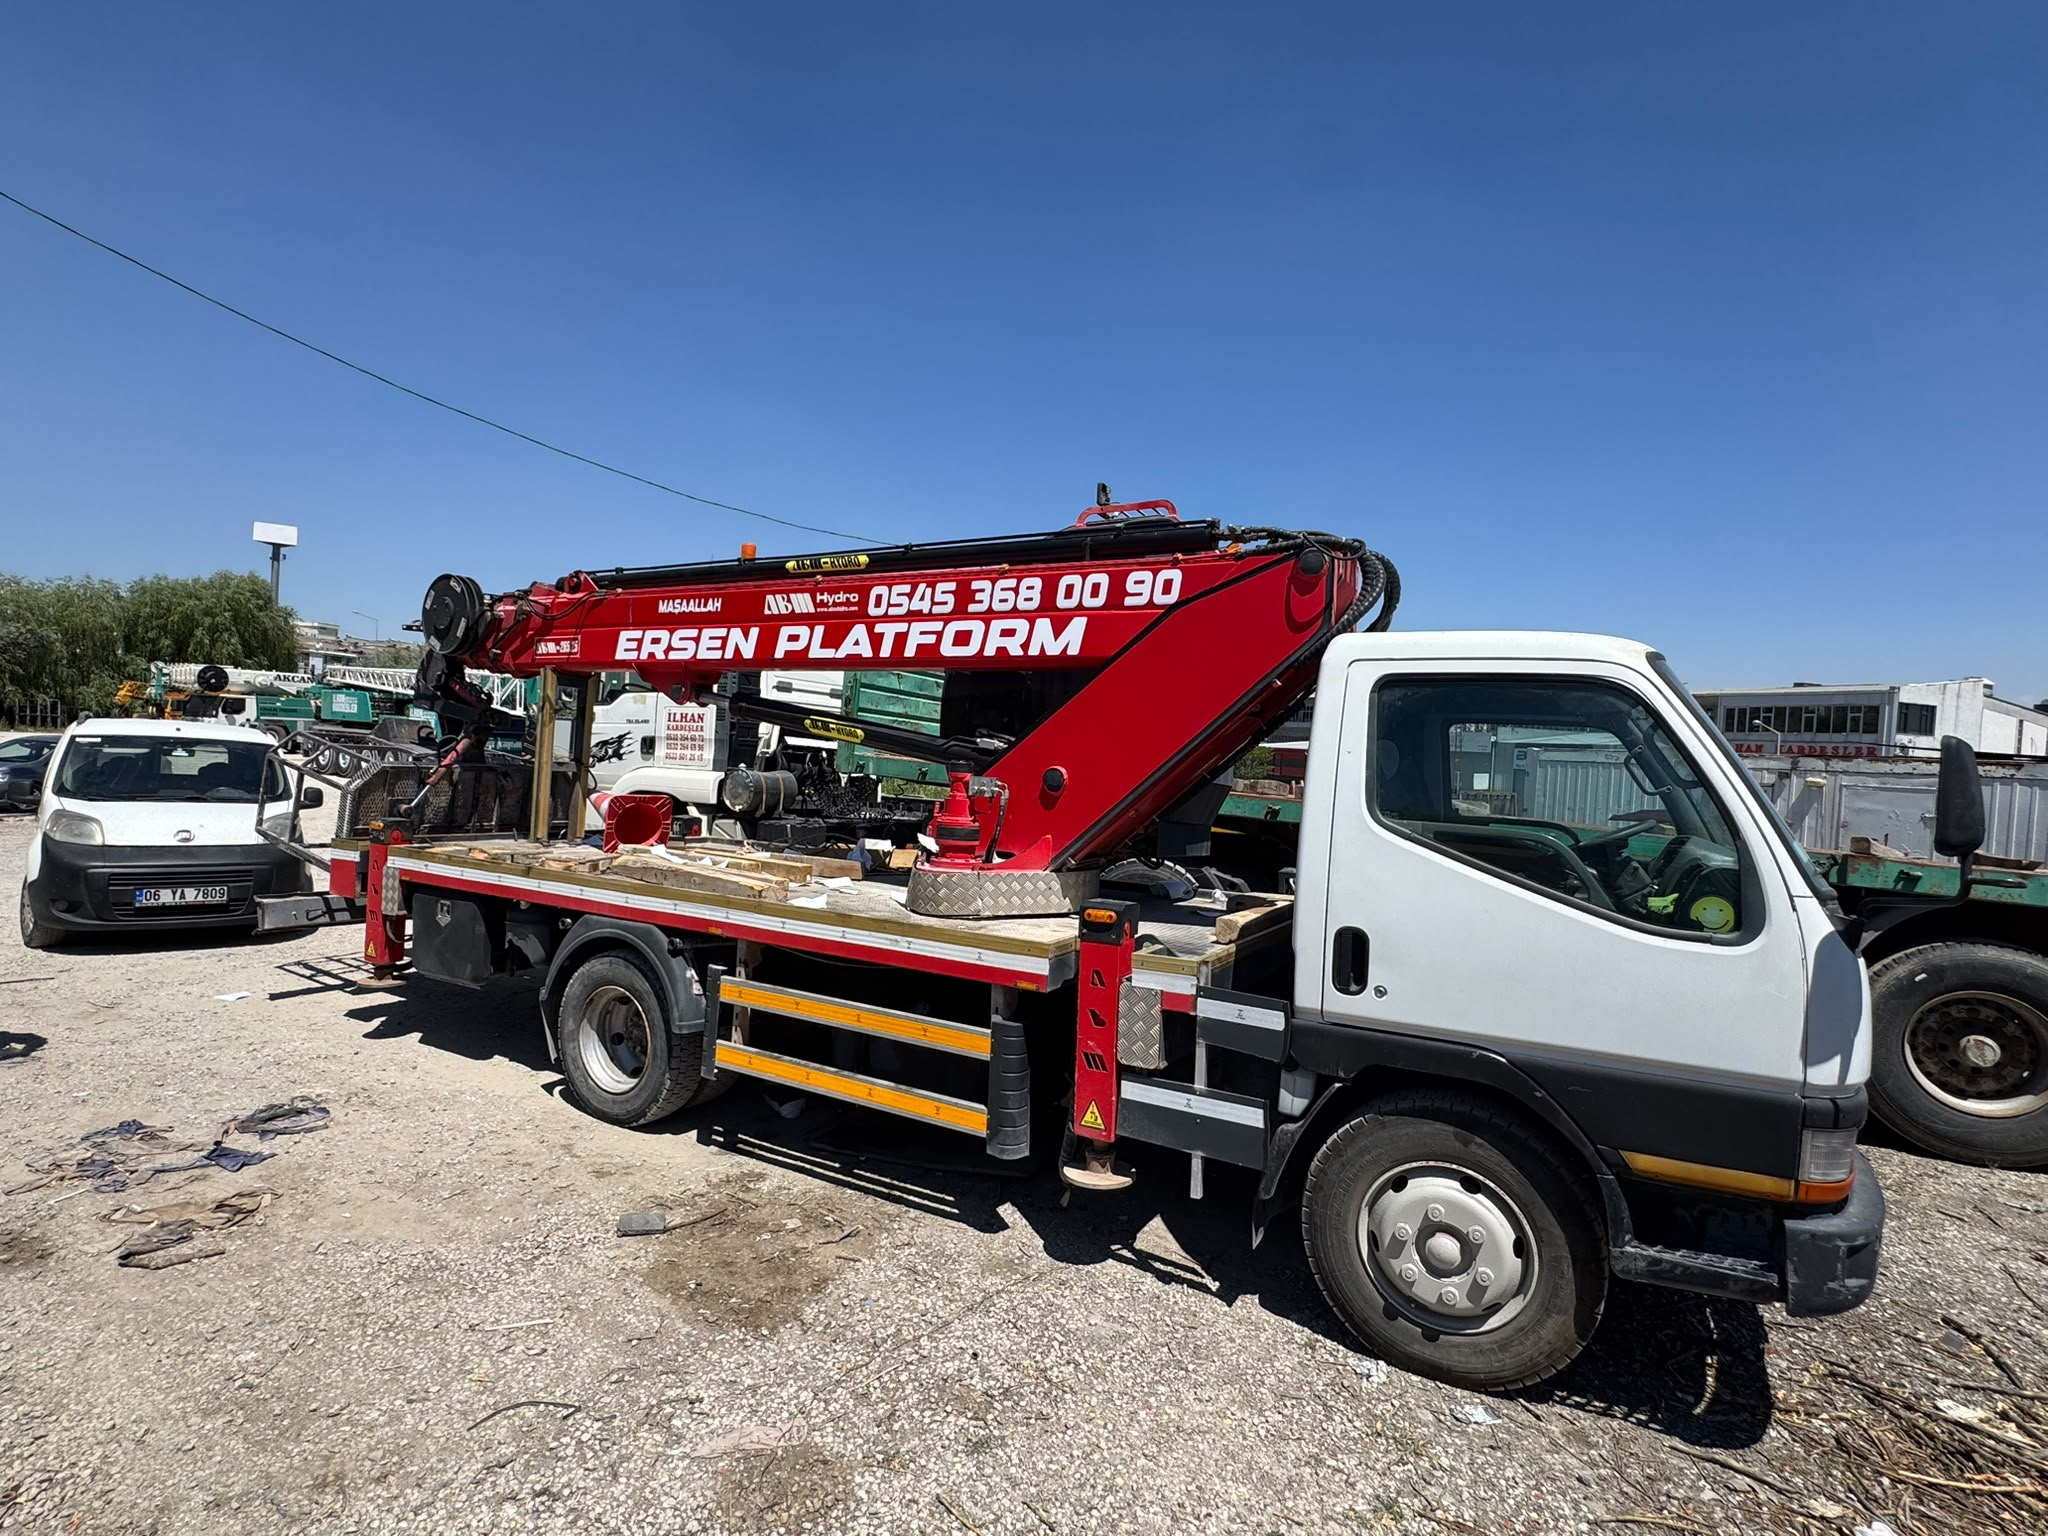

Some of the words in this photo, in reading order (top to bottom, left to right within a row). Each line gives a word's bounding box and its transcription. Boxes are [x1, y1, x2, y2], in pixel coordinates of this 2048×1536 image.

[817, 591, 859, 606] Hydro
[868, 582, 956, 616] 0545
[968, 577, 1042, 612] 368
[1056, 573, 1109, 608] 00
[1124, 569, 1182, 606] 90
[658, 598, 722, 615] MAŞAALLAH
[614, 627, 760, 660] ERSEN
[774, 616, 1088, 659] PLATFORM
[667, 709, 705, 723] İLHAN
[666, 723, 704, 734] KARDEŞLER
[1734, 743, 1764, 753] HAN
[144, 889, 161, 902] 06
[171, 888, 186, 901] YA
[193, 887, 226, 900] 7809
